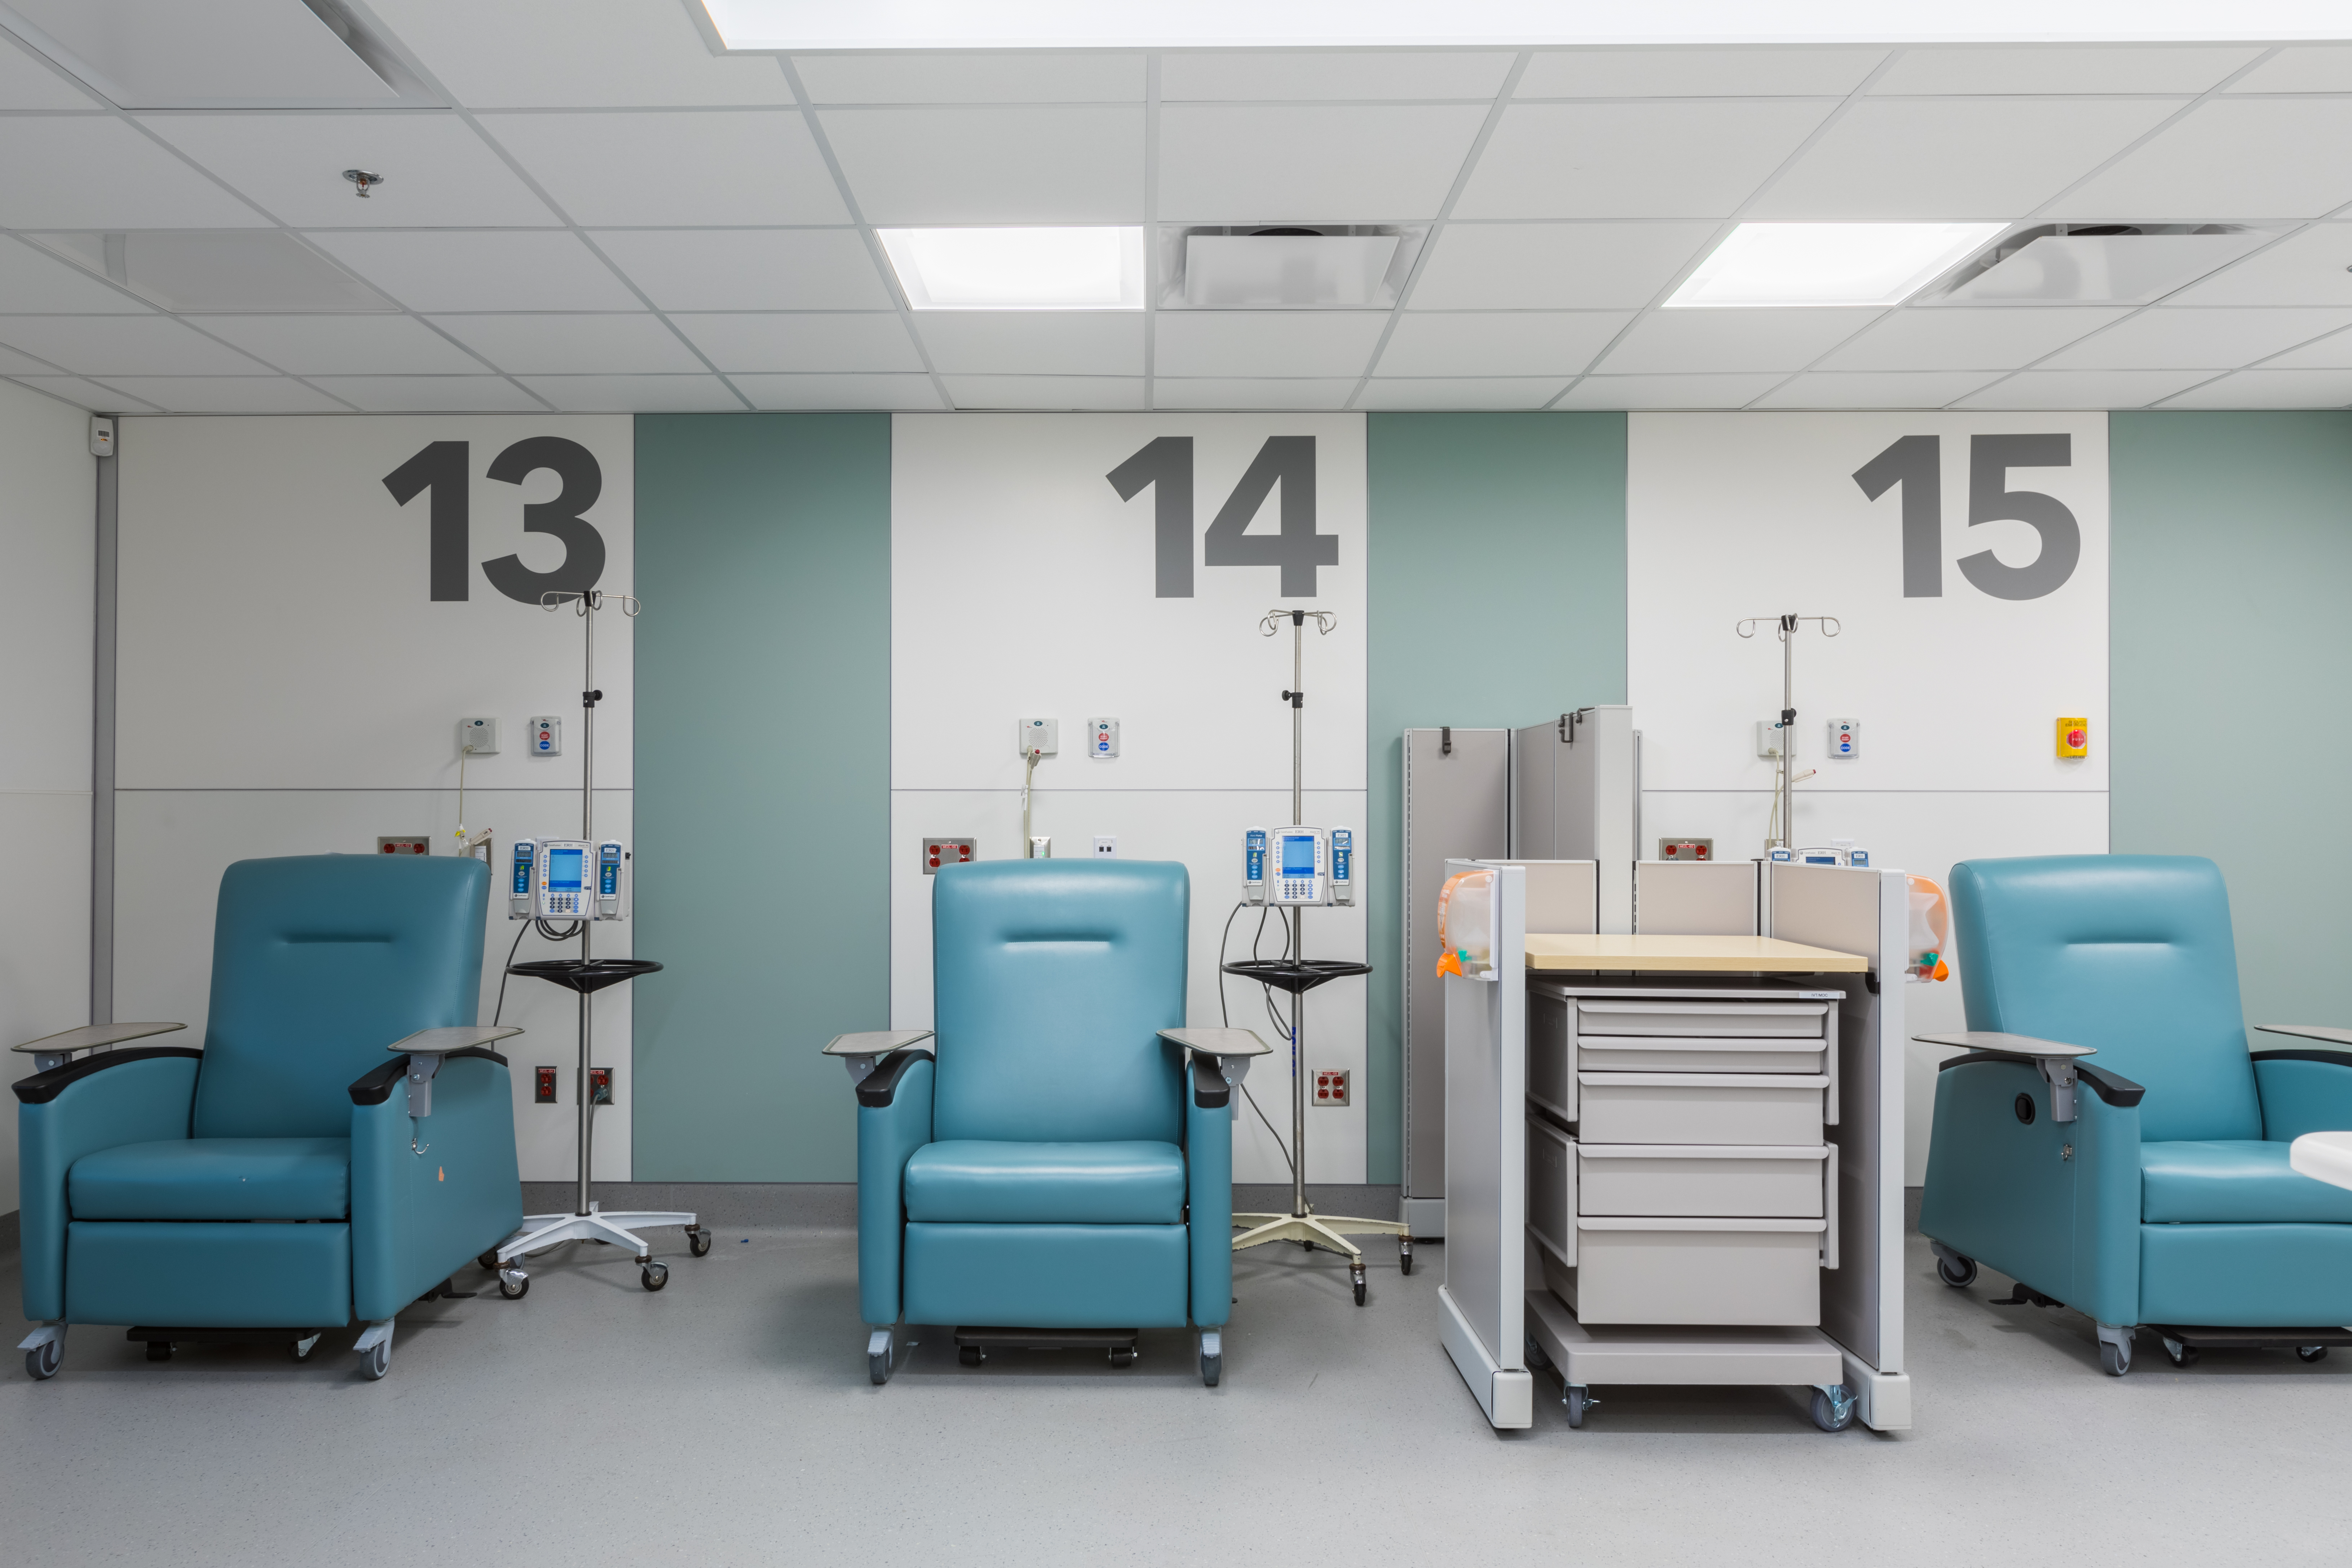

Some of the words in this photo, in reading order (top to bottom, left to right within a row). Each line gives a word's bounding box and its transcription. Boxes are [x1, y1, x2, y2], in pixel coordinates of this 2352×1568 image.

[381, 436, 606, 605] 13
[1106, 436, 1338, 598] 14
[1852, 433, 2081, 601] 15
